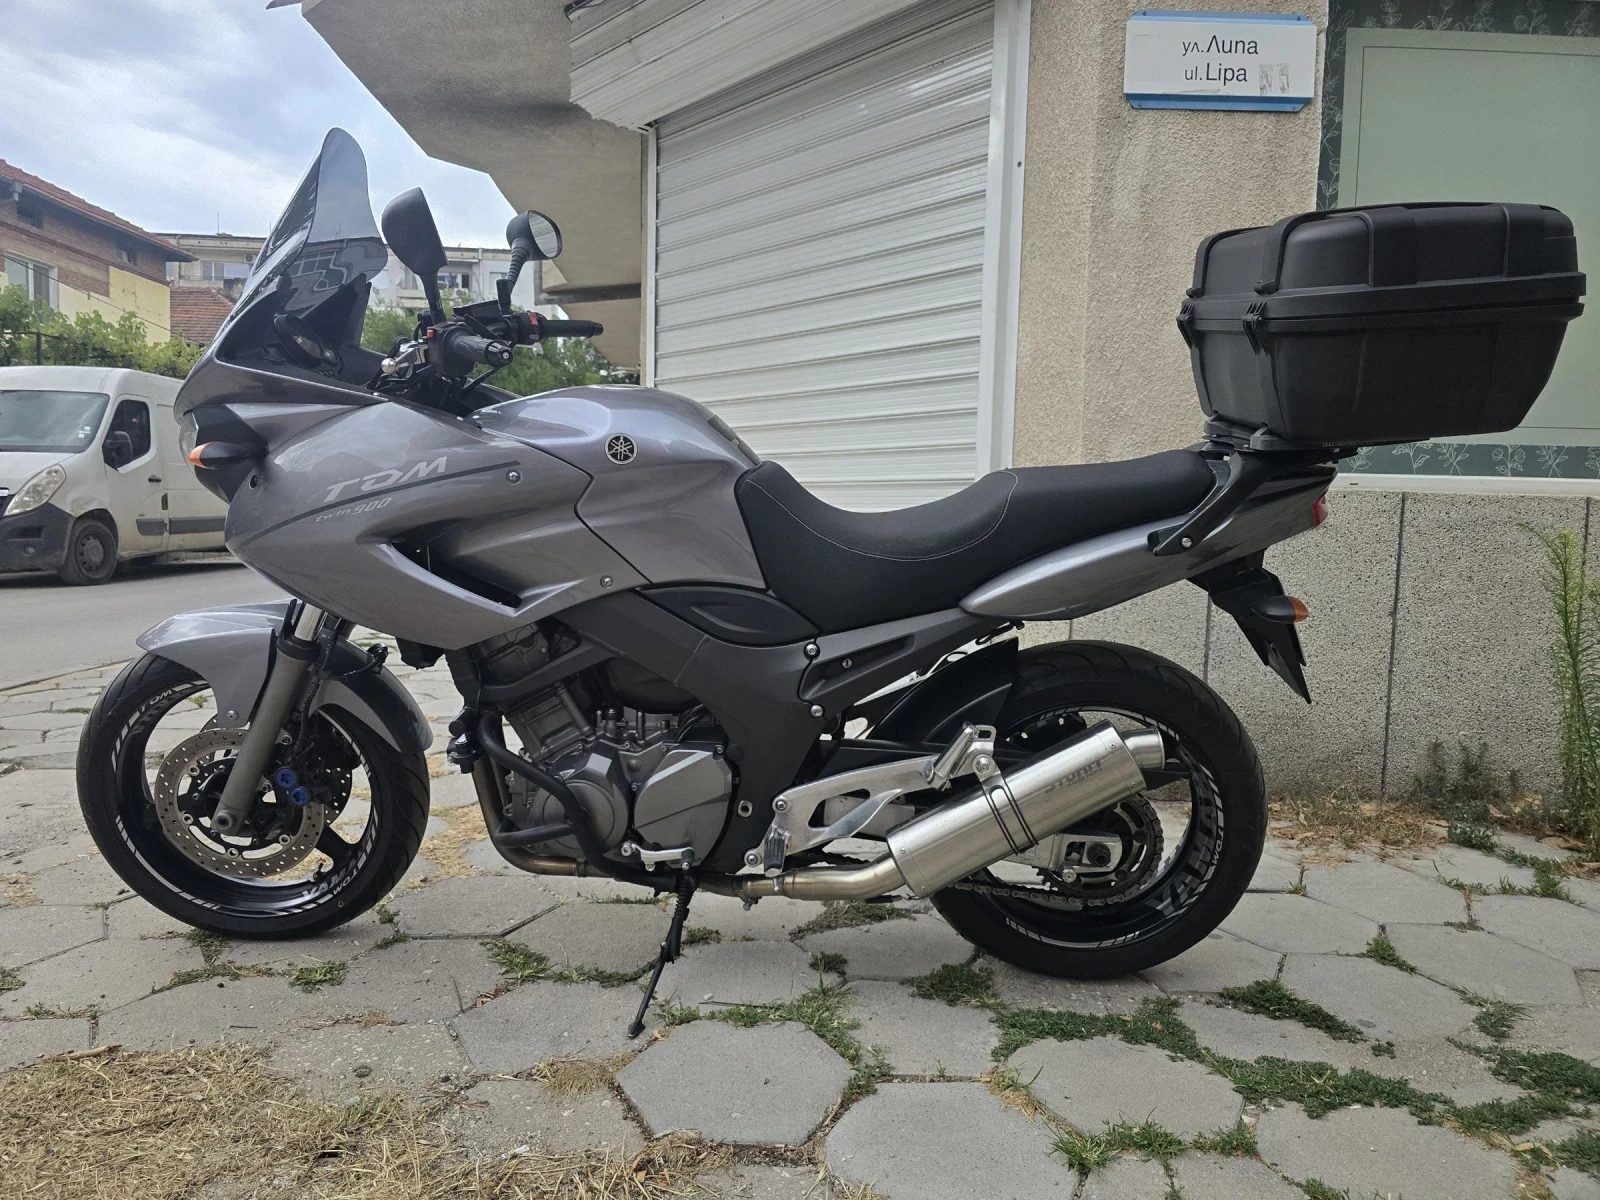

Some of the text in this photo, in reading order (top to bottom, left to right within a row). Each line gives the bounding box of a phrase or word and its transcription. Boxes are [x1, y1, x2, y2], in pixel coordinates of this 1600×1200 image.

[324, 456, 447, 503] TDM
[316, 497, 392, 522] twin 900
[141, 689, 172, 712] TDM
[1212, 828, 1225, 865] TDM
[333, 867, 358, 895] TDM
